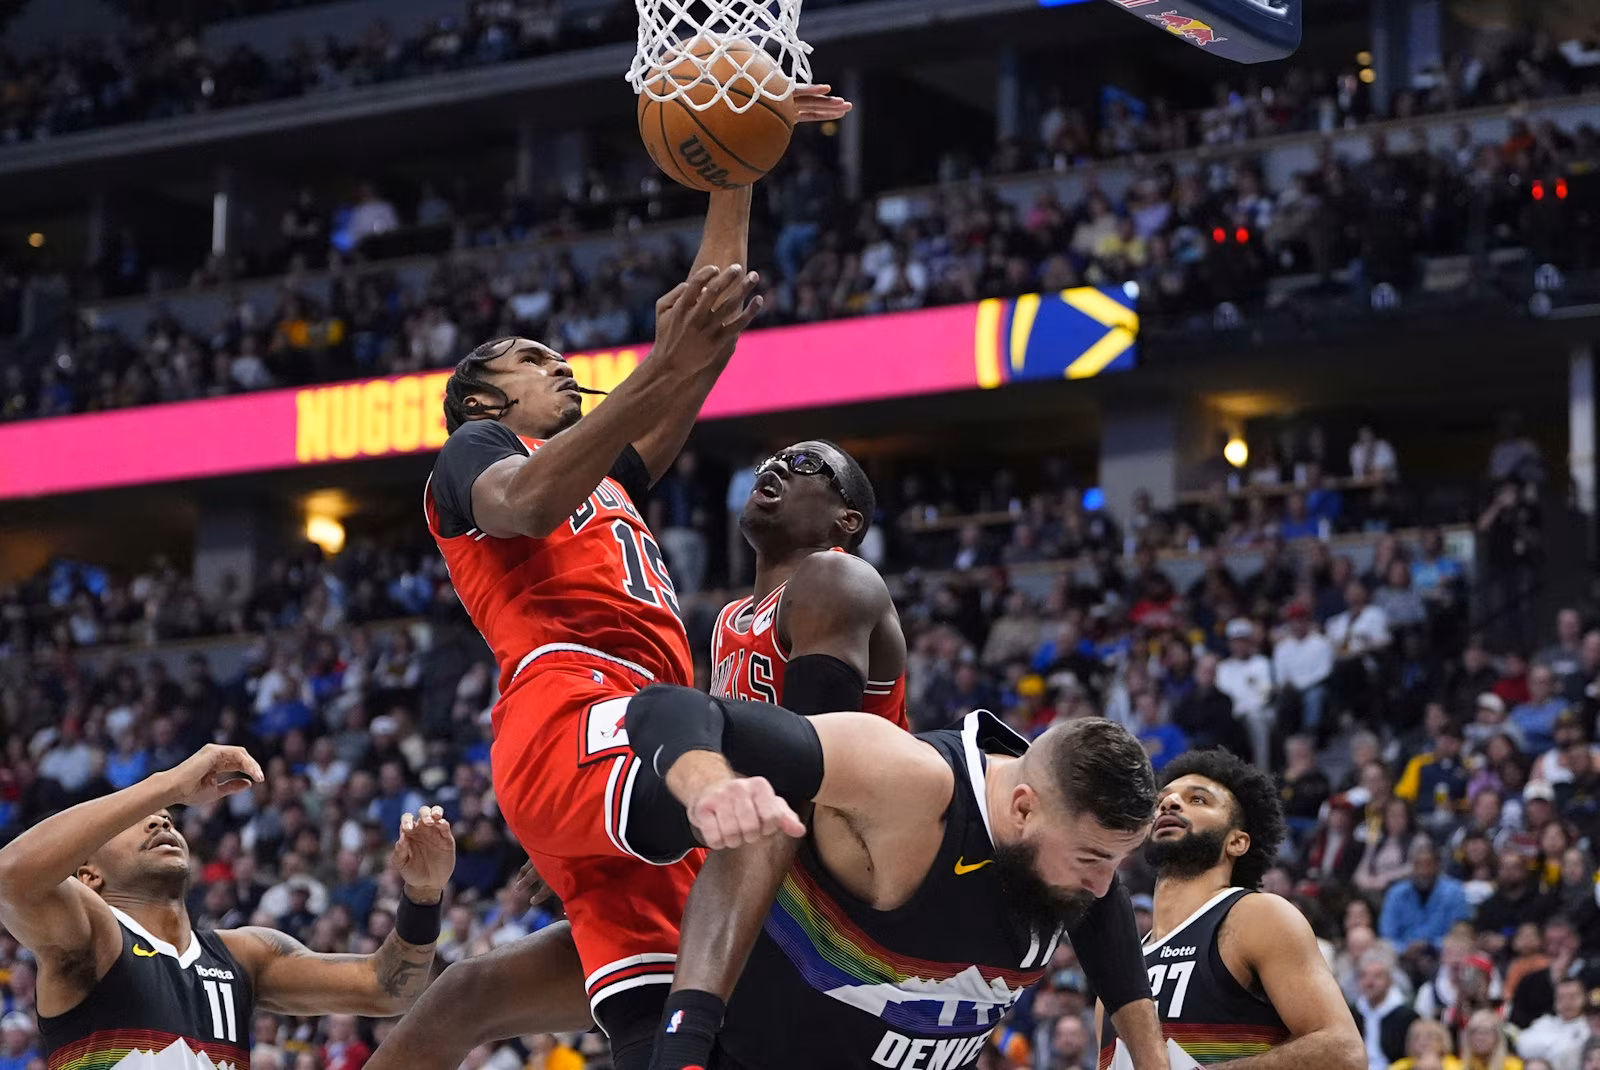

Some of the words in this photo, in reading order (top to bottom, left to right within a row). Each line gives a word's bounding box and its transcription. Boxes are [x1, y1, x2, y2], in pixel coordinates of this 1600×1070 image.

[297, 372, 451, 462] NUGGE
[195, 964, 234, 980] ibotta
[1160, 946, 1196, 958] ibotta
[203, 980, 237, 1042] 11
[871, 1027, 994, 1070] DENVE
